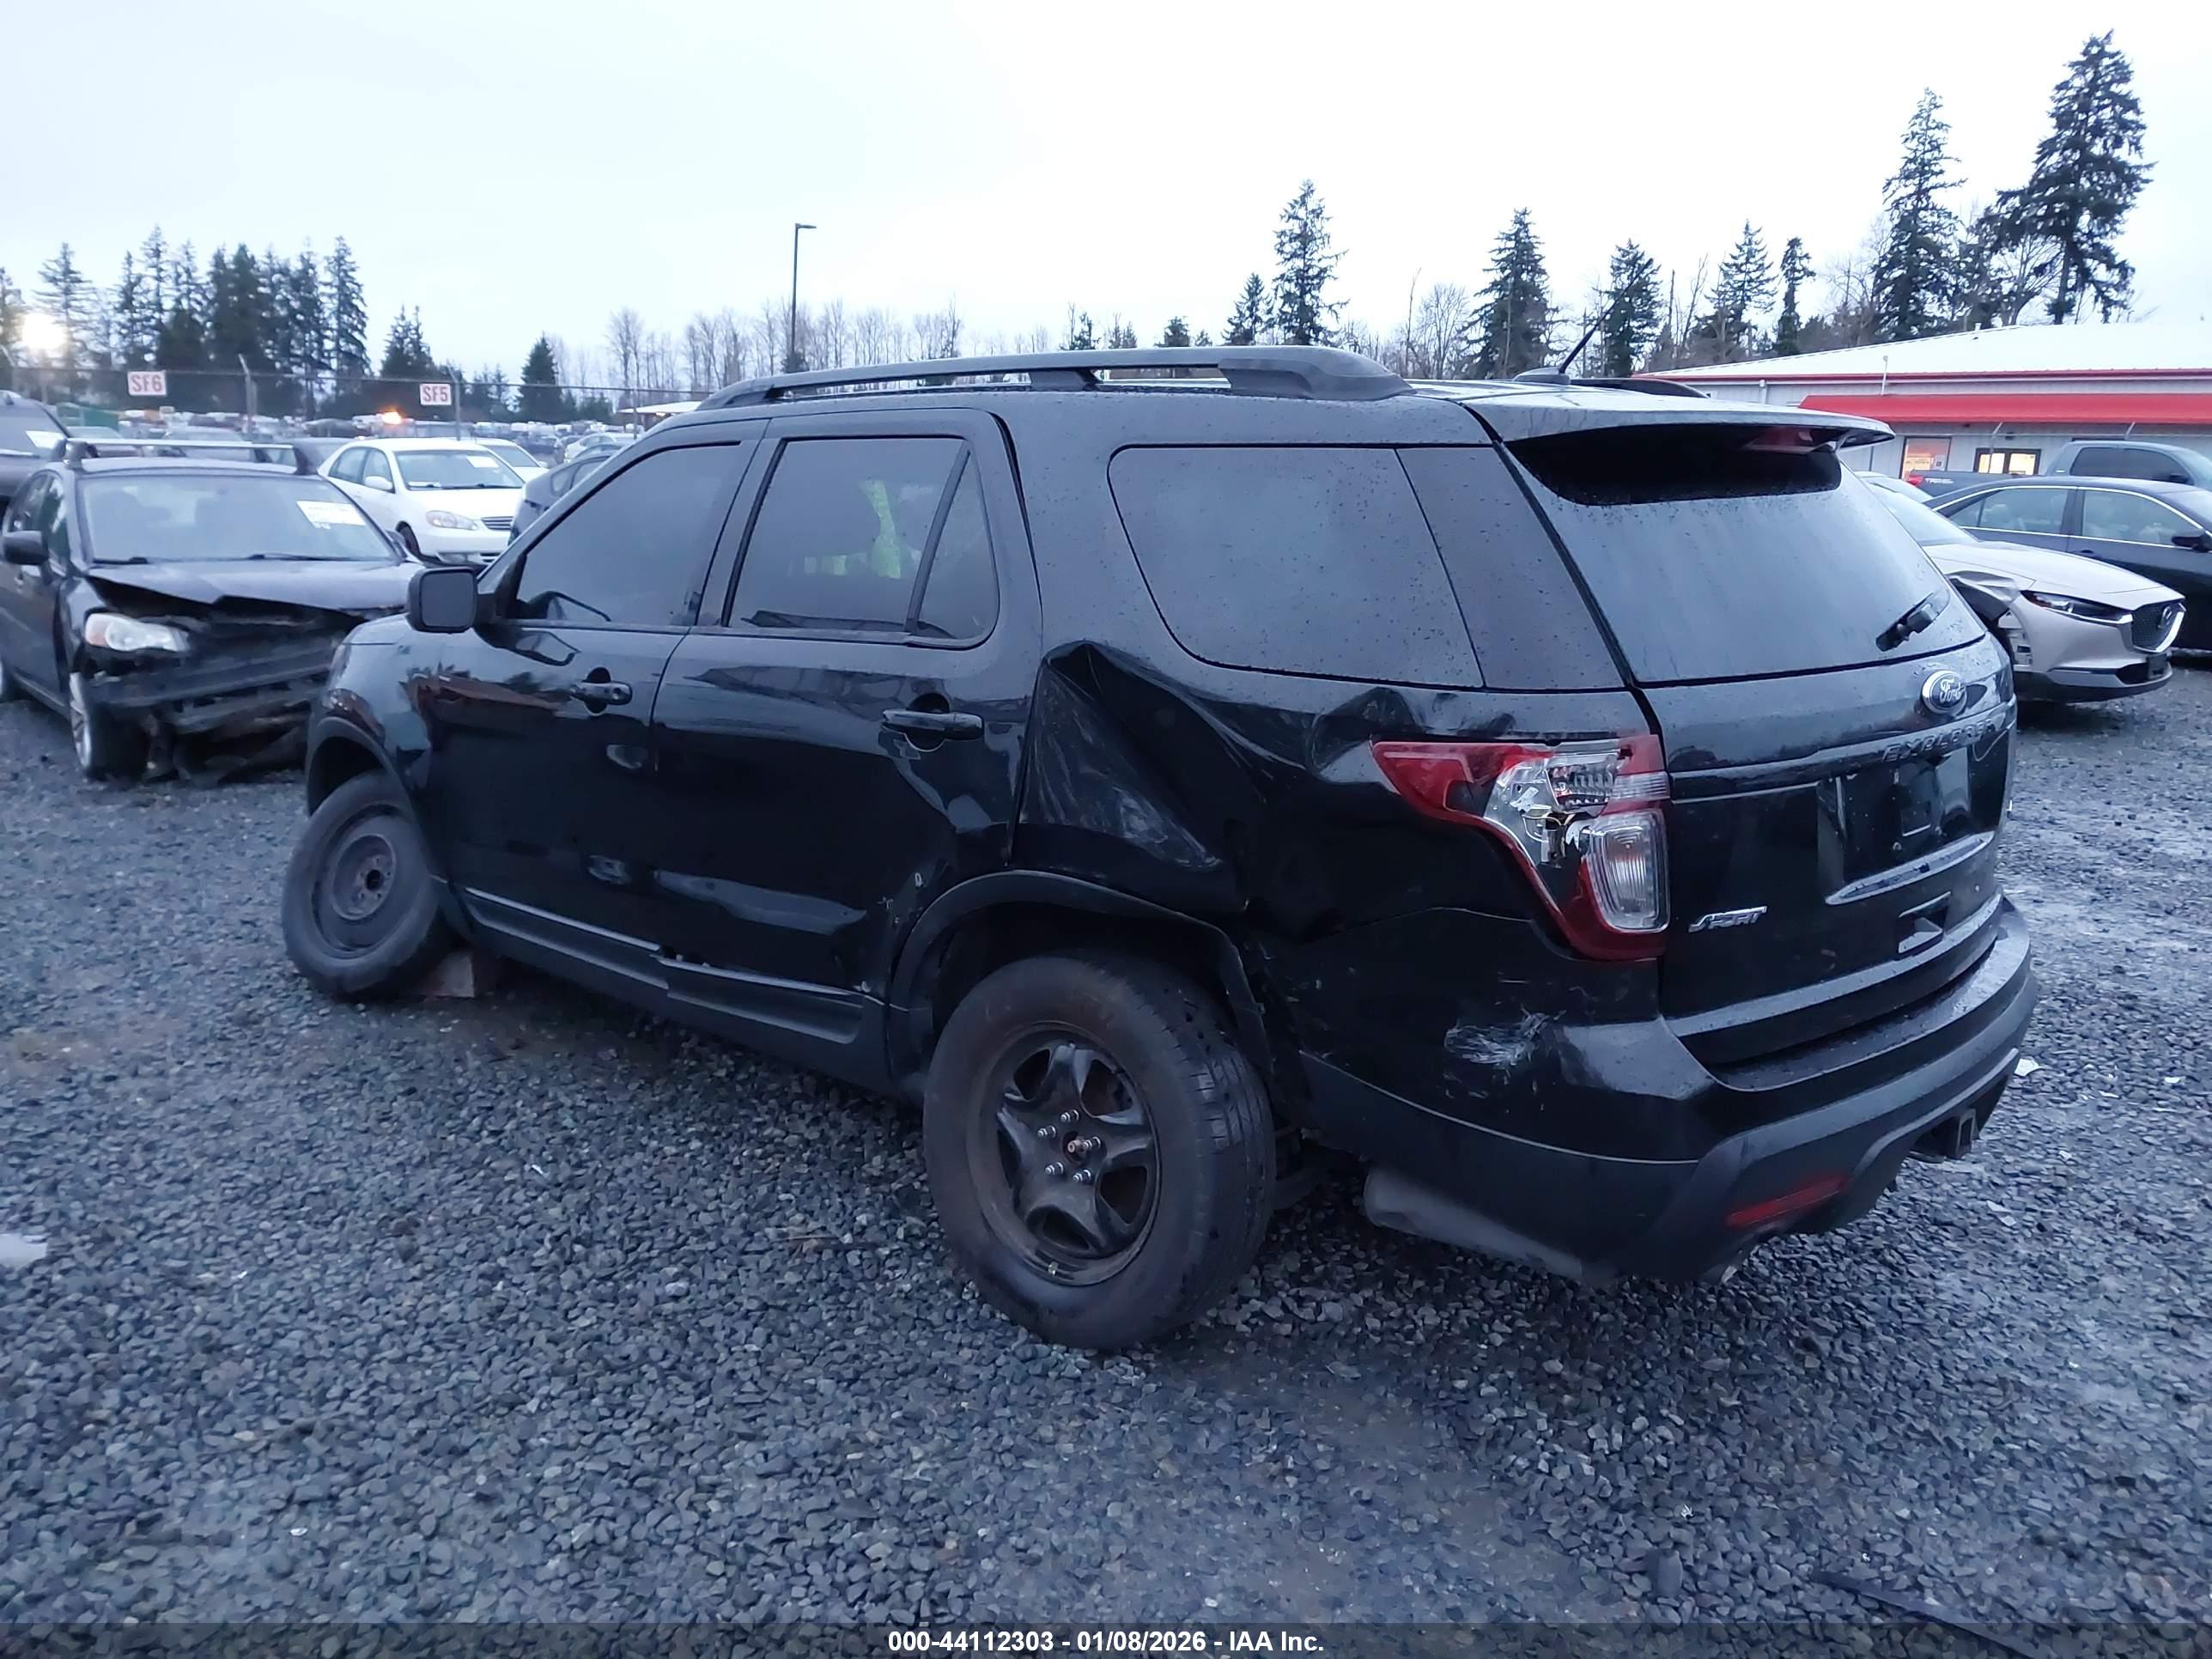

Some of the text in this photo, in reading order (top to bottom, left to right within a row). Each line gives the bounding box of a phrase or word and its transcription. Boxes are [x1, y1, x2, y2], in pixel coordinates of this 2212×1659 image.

[131, 374, 163, 392] SF6
[422, 386, 449, 403] SF5
[1938, 678, 1966, 704] Ford
[1881, 719, 1996, 763] EXPLORER
[1687, 905, 1768, 933] SPORT
